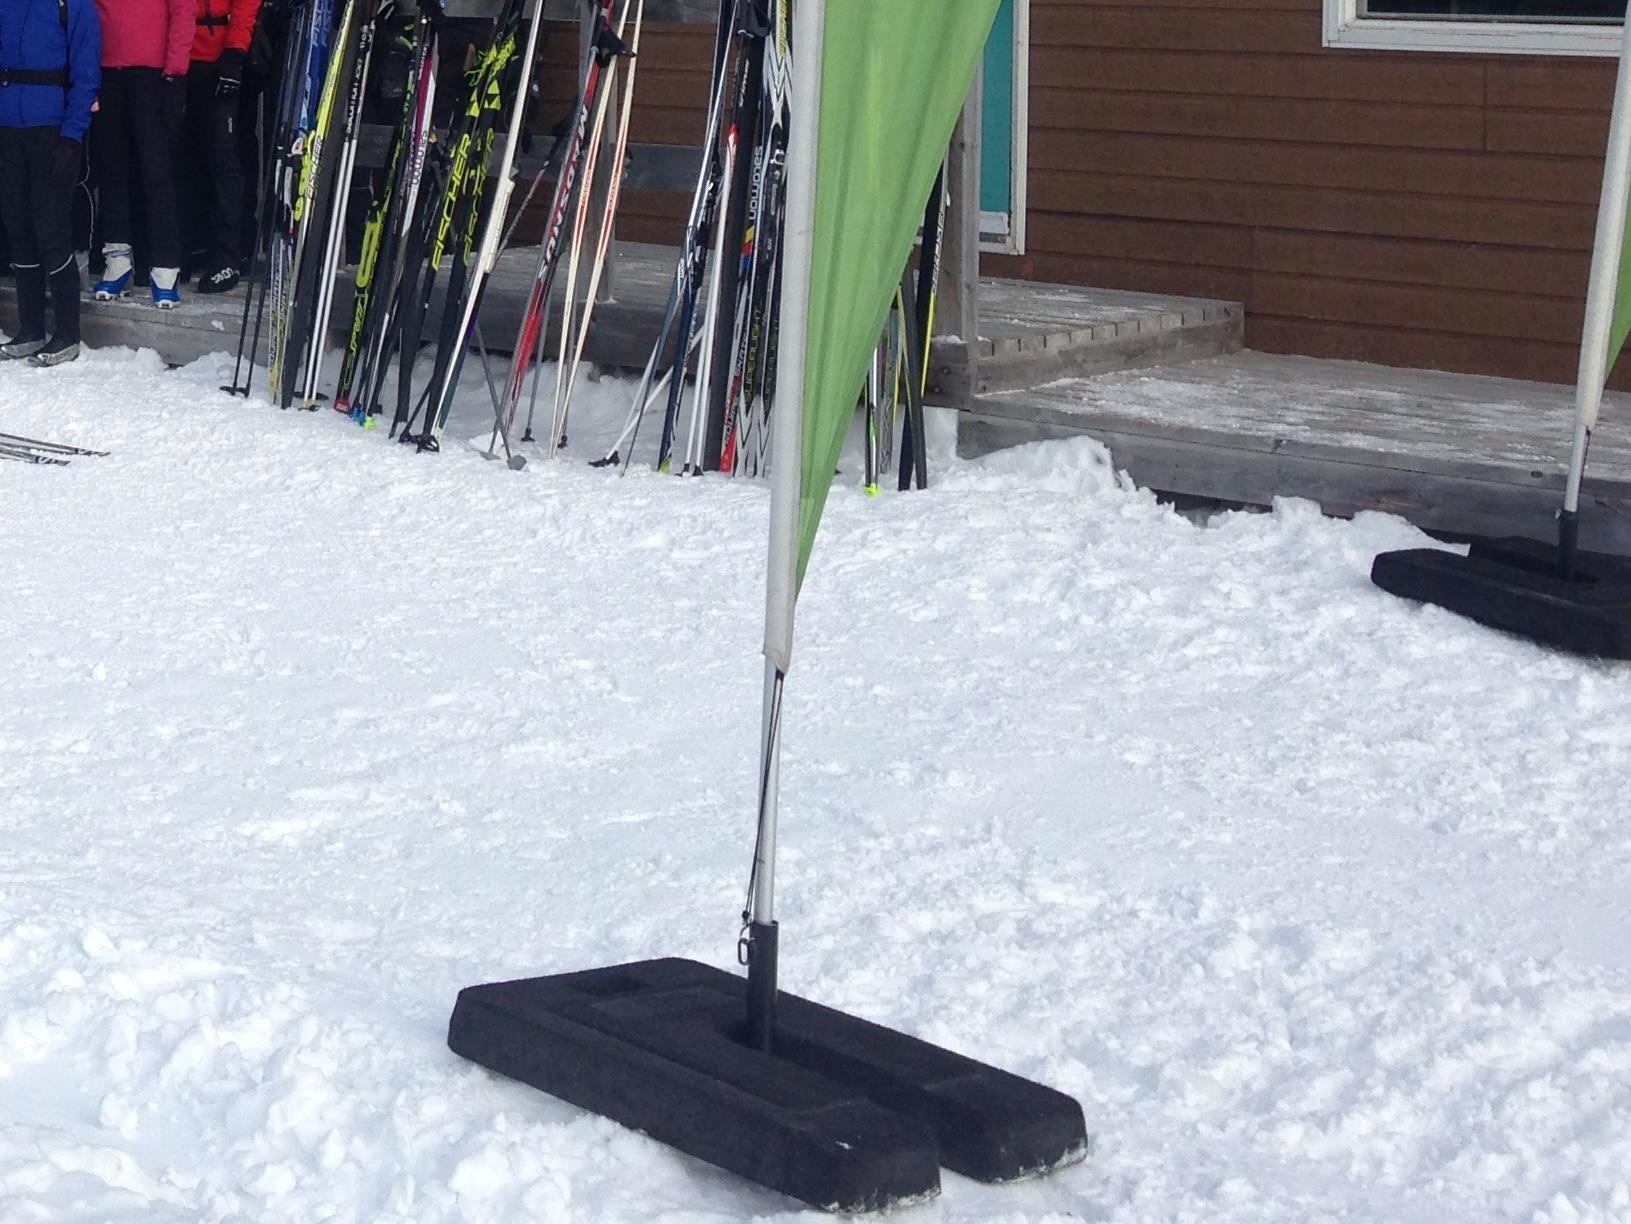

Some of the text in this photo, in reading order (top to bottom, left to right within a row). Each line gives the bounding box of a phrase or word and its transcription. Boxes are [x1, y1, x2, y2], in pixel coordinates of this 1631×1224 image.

[305, 137, 324, 198] FISCHER
[413, 130, 428, 186] salomon
[538, 104, 589, 284] MADSHUS
[748, 145, 764, 221] salomon
[431, 132, 472, 271] FISCHER
